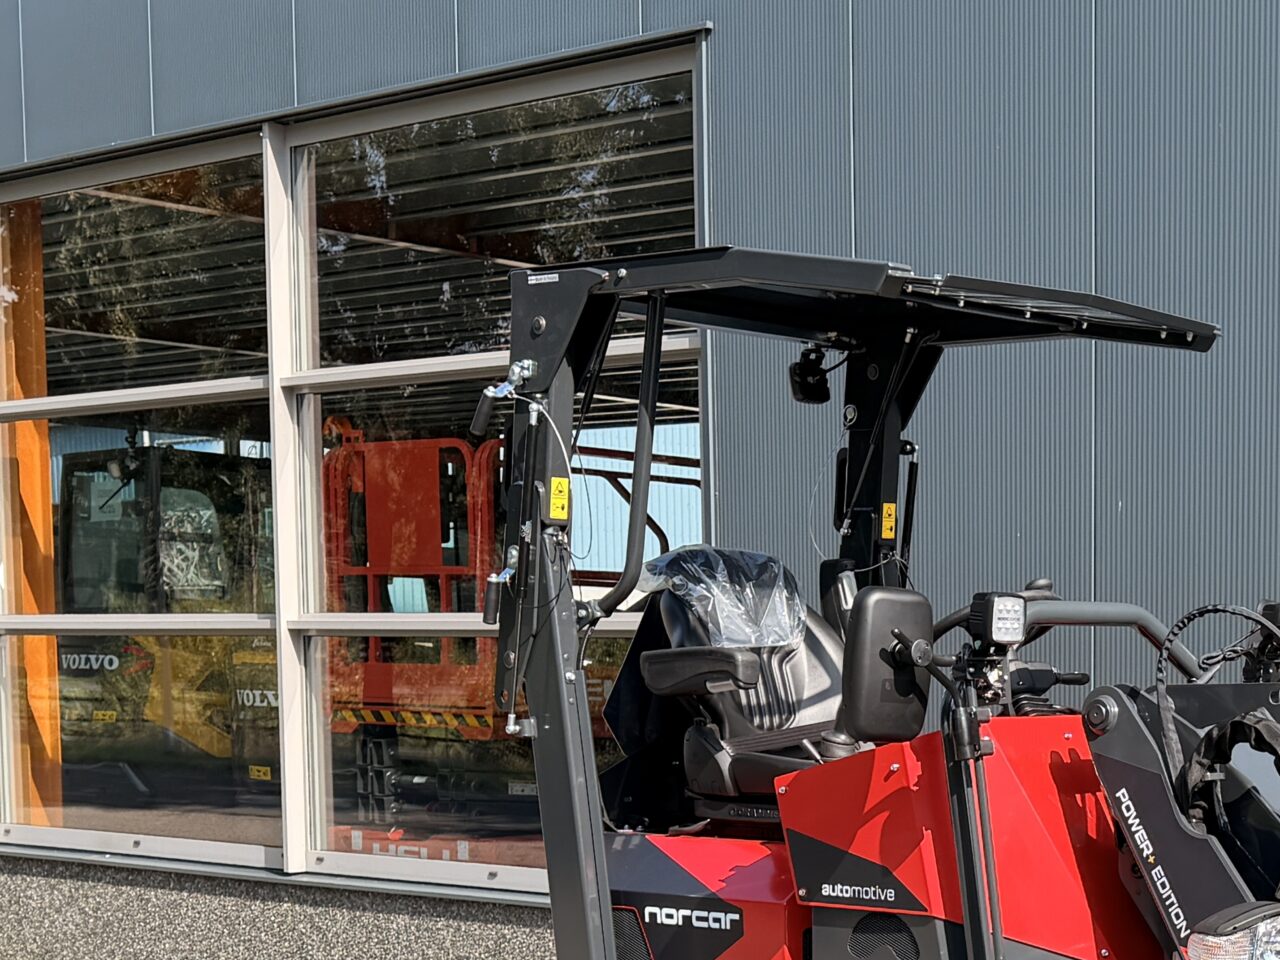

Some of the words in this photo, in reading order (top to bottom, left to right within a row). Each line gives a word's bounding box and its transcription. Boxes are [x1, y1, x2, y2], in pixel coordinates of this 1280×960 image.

[61, 653, 120, 670] VOLVO
[1115, 787, 1156, 864] POWER+
[1151, 864, 1191, 939] EDITION
[821, 883, 895, 901] automotive
[644, 905, 740, 930] norcar
